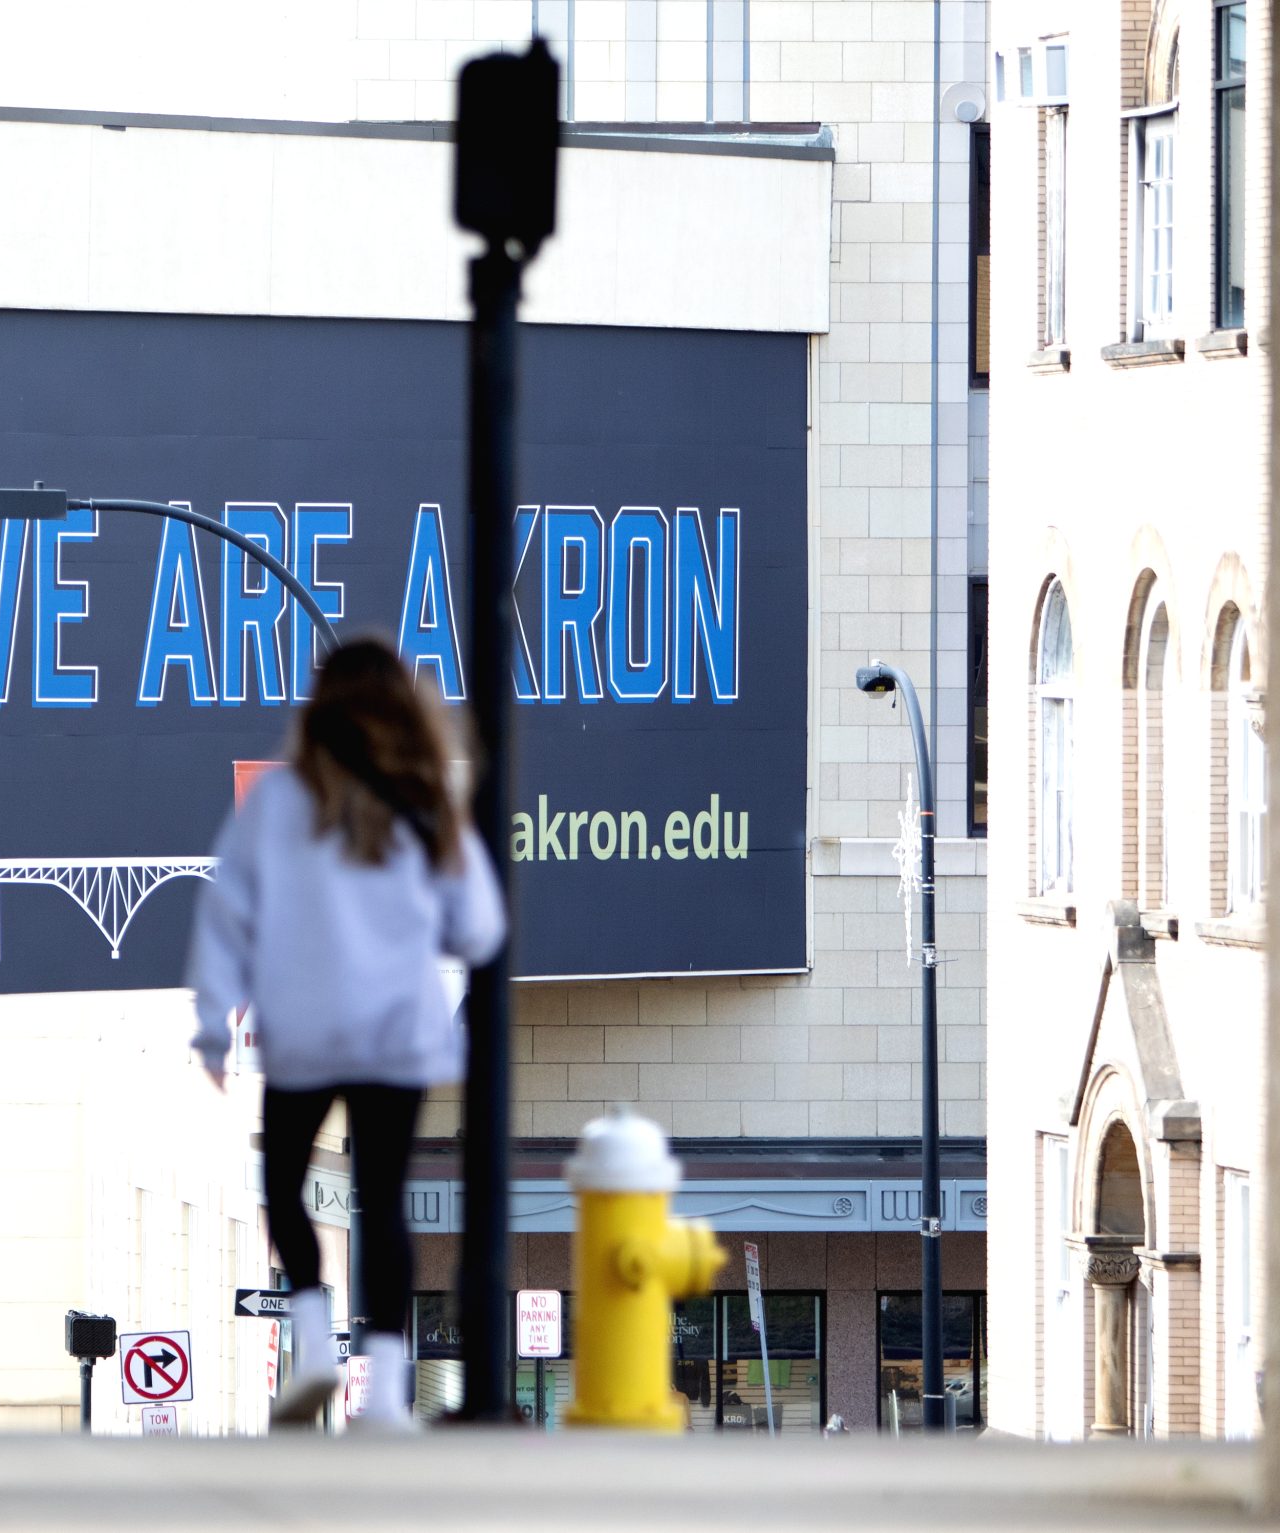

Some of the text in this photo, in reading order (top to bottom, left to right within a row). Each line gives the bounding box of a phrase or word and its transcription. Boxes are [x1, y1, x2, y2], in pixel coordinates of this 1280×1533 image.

[136, 500, 353, 707] ARE
[511, 794, 749, 861] akron.edu
[261, 1298, 285, 1310] ONE
[531, 1296, 547, 1309] NO
[521, 1310, 557, 1322] PARKING
[530, 1325, 546, 1333] ANY
[529, 1335, 548, 1344] TIME
[150, 1414, 169, 1425] TOW
